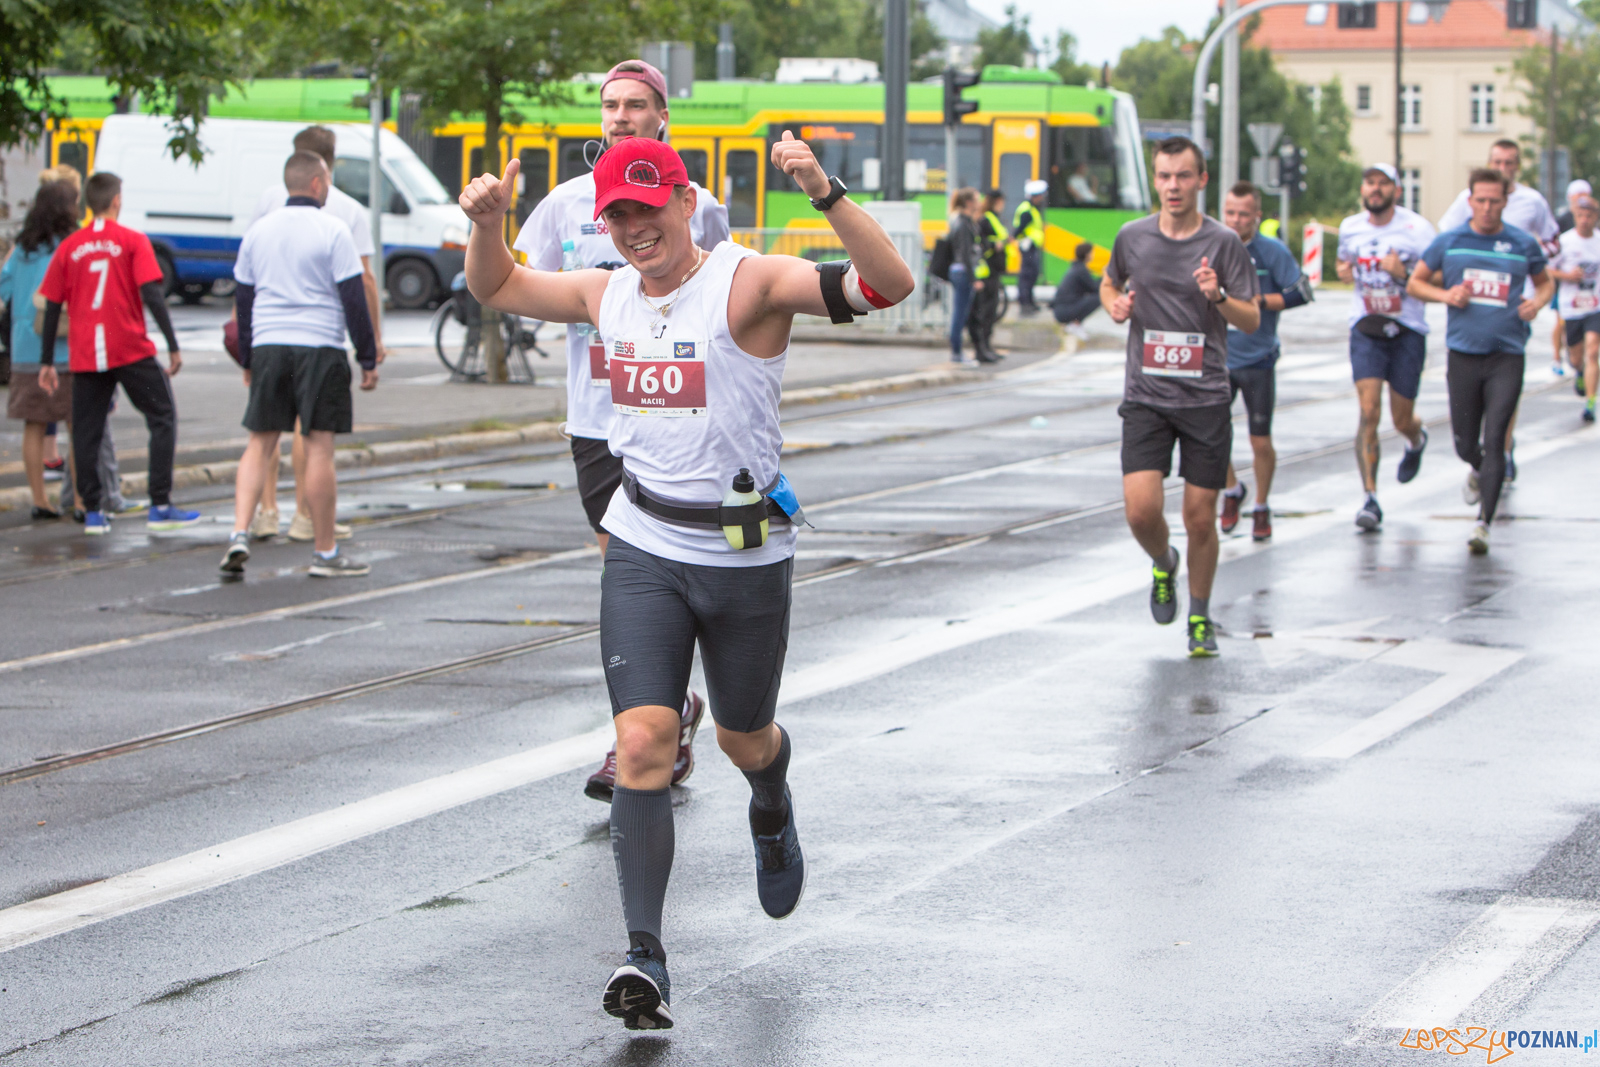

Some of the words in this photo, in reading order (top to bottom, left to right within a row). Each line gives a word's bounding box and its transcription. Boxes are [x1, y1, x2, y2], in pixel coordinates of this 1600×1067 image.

[90, 259, 109, 309] 7
[1472, 280, 1500, 297] 912
[1153, 345, 1192, 365] 869
[623, 365, 683, 394] 760
[641, 397, 665, 406] MACIEJ
